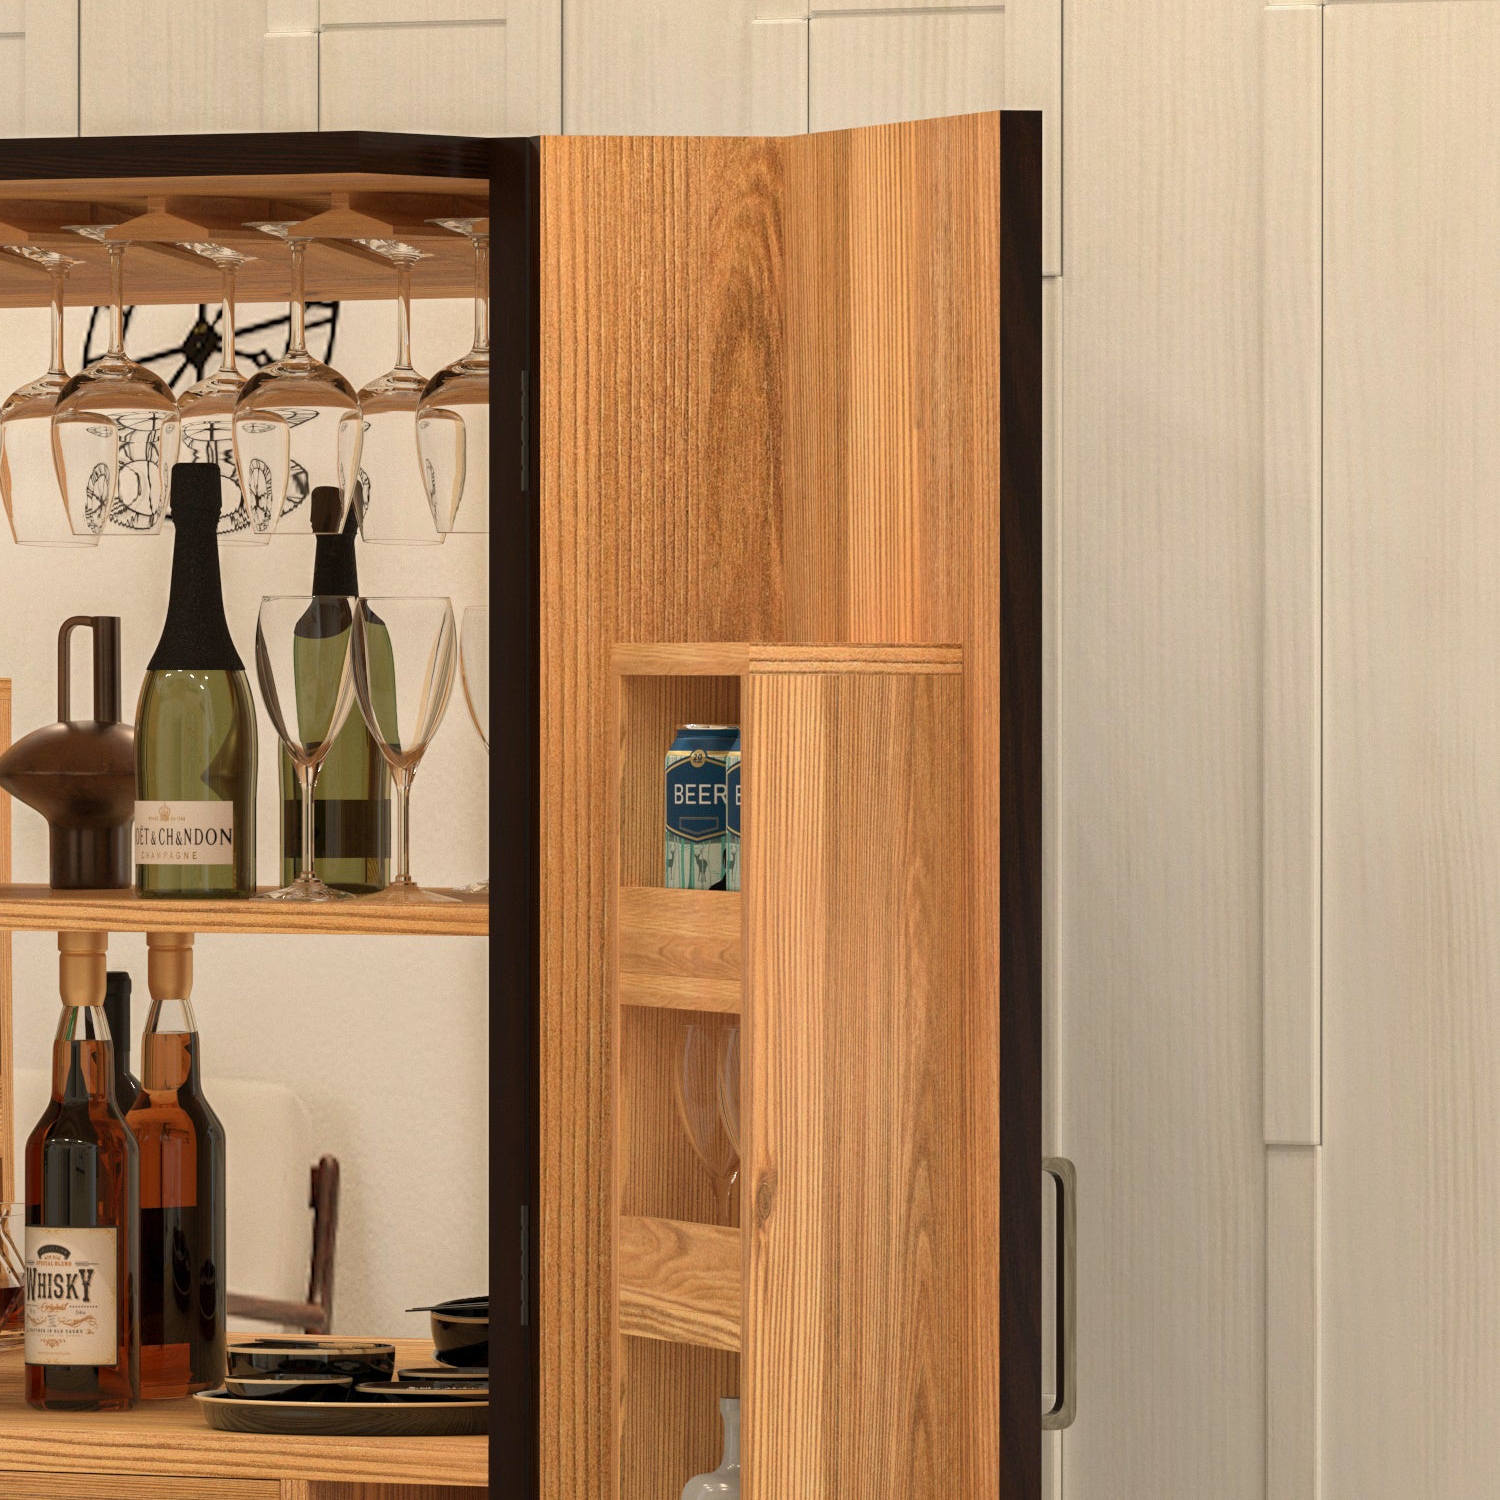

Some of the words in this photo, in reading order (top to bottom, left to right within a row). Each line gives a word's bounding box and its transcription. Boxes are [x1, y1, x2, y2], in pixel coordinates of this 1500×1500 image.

[674, 783, 727, 805] BEER
[141, 851, 197, 860] CHAMPAGNE
[26, 1267, 94, 1302] WHISKY
